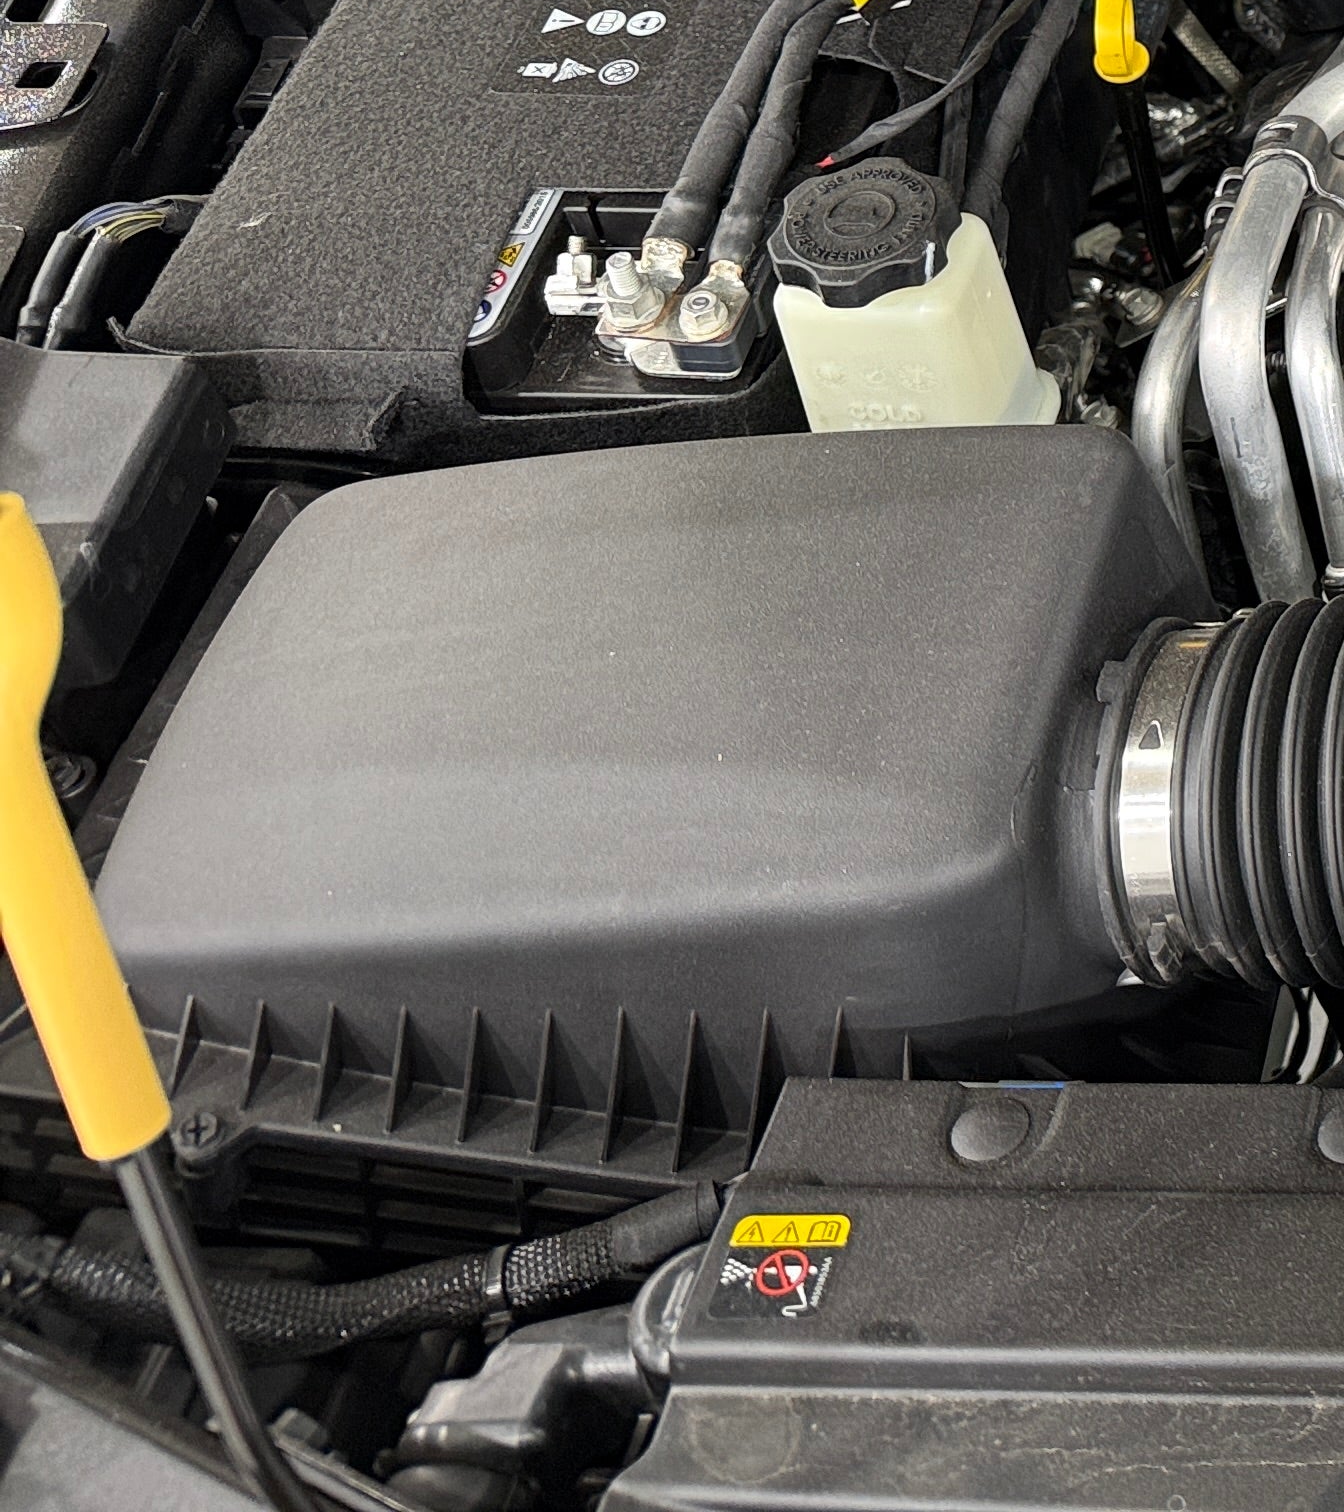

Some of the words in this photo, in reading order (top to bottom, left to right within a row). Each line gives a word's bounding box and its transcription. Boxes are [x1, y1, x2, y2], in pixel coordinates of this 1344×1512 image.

[815, 174, 847, 195] USE
[849, 168, 926, 195] APPROVED
[848, 402, 922, 423] COLD
